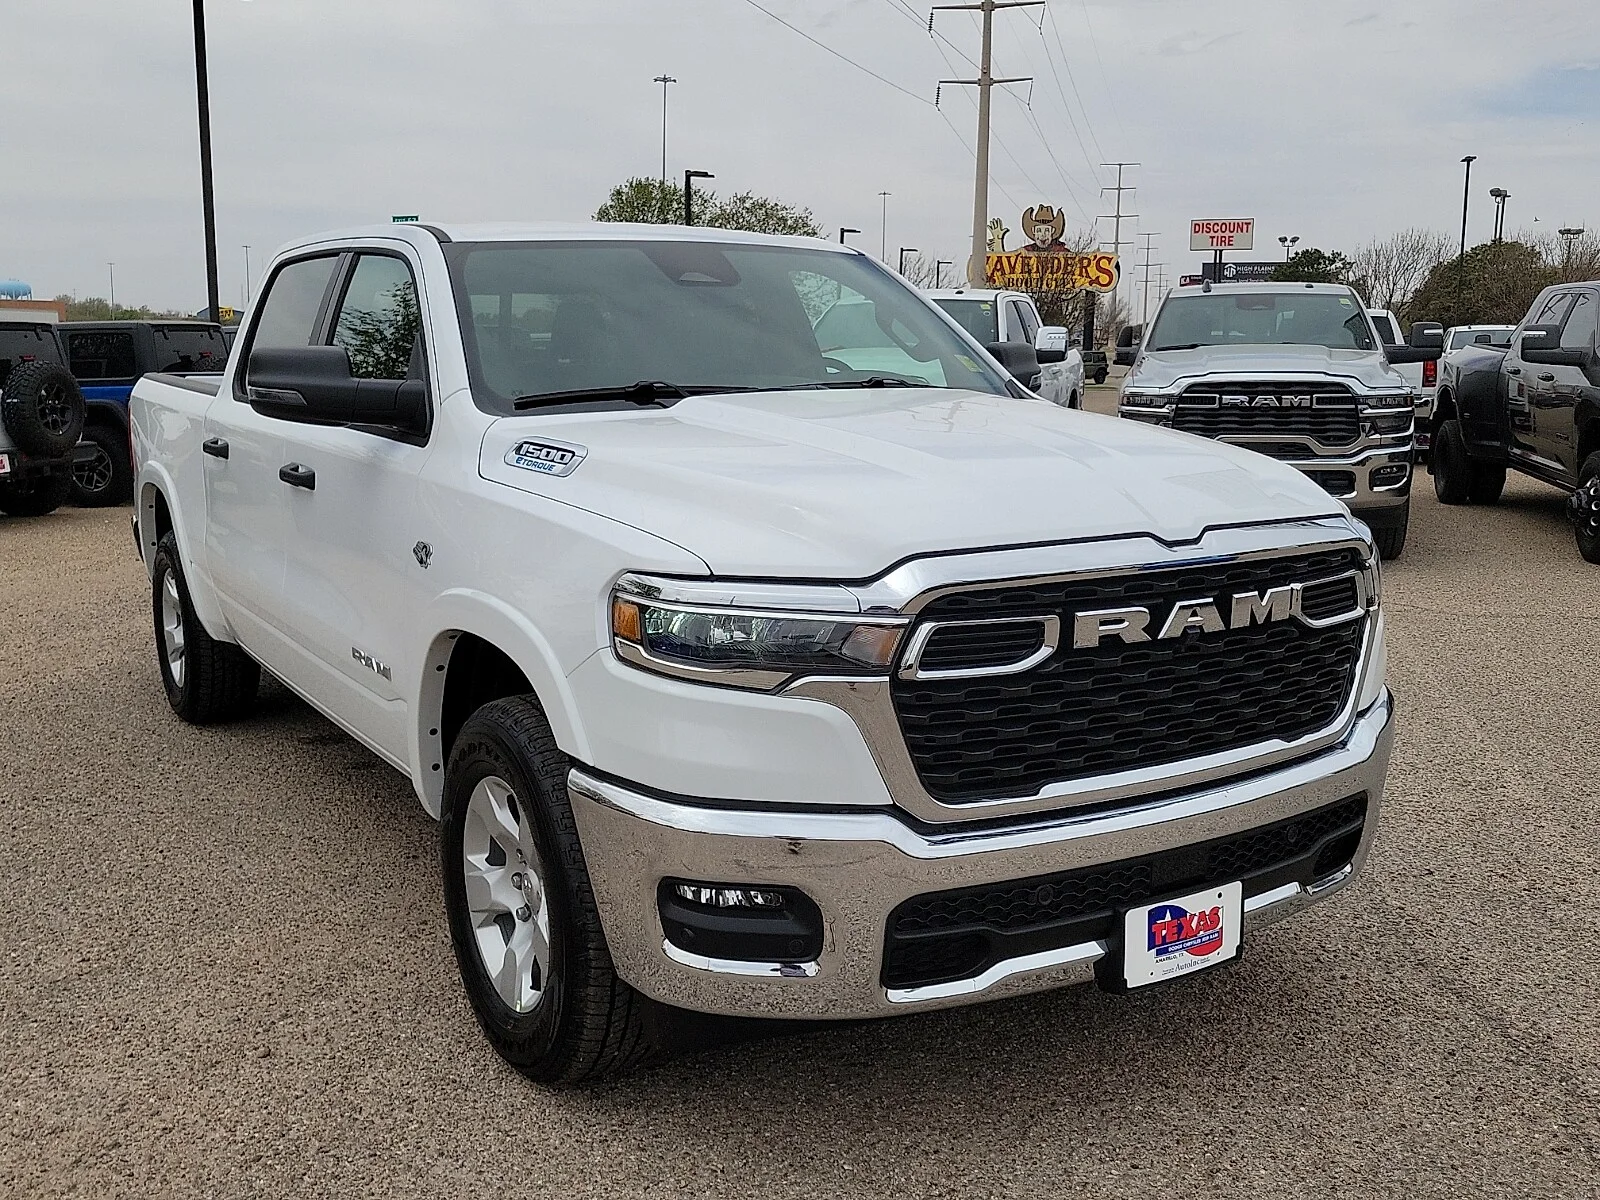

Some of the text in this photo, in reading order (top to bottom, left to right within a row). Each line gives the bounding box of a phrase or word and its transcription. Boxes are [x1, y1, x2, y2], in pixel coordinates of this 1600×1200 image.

[1193, 221, 1252, 234] DISCOUNT
[1209, 235, 1235, 247] TIRE
[986, 252, 1114, 288] AVENDER'S
[1222, 395, 1311, 407] RAM
[519, 443, 575, 464] 1500
[1073, 585, 1291, 650] RAM
[351, 646, 392, 682] RAM
[1151, 906, 1221, 946] TEXAS
[1168, 944, 1182, 952] DODGE
[1183, 939, 1201, 947] CHRYSLER
